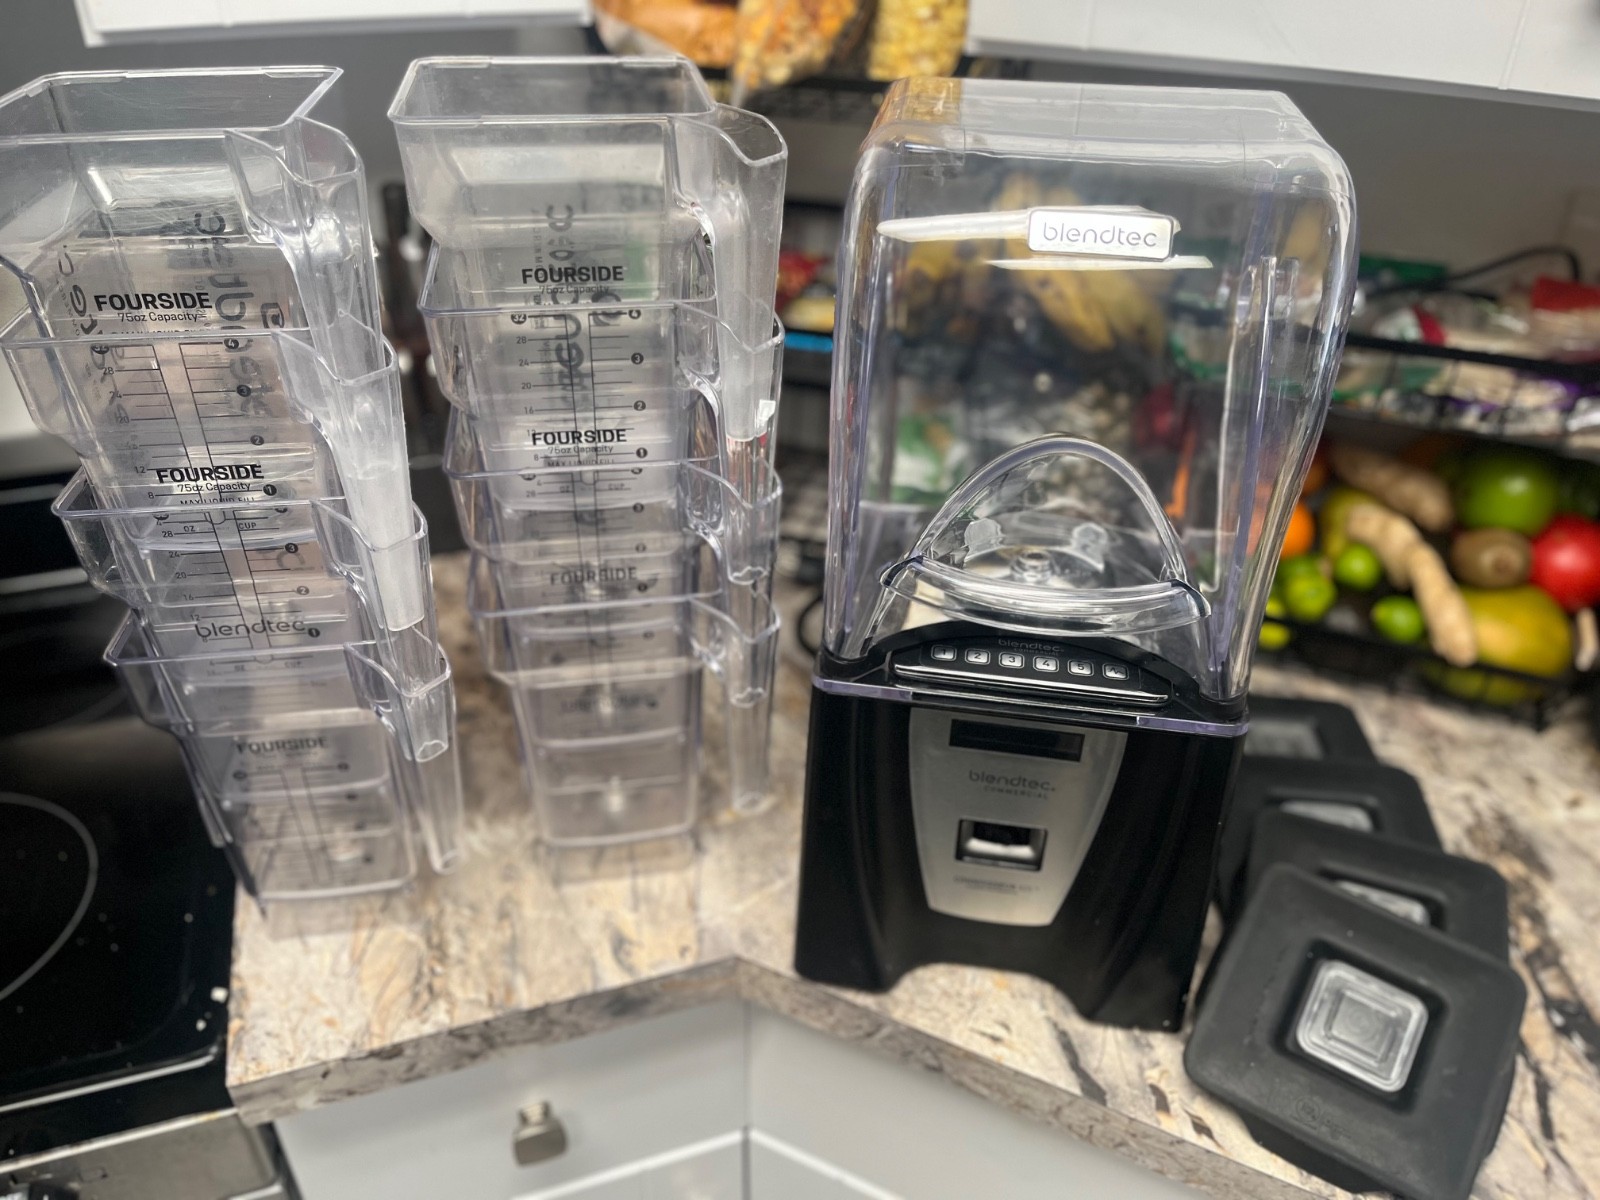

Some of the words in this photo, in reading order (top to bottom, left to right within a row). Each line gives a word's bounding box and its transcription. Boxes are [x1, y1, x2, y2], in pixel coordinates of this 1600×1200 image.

[1043, 221, 1158, 247] blendtec
[521, 265, 625, 285] FOURSIDE
[539, 285, 564, 295] 75oz
[566, 284, 610, 295] Capacity
[93, 292, 213, 312] FOURSIDE
[117, 312, 148, 323] 75oz
[149, 311, 198, 323] Capacity
[516, 336, 527, 344] 28
[519, 359, 529, 367] 24
[632, 353, 643, 364] 3
[102, 366, 115, 375] 28
[521, 382, 532, 390] 20
[634, 400, 645, 411] 2
[251, 435, 263, 445] 2
[531, 428, 627, 446] FOURSIDE
[573, 444, 614, 454] Capacity
[155, 464, 264, 484] FOURSIDE
[177, 484, 204, 493] 75oz
[206, 482, 251, 492] Capacity
[148, 491, 155, 499] 8
[183, 525, 196, 533] OZ
[238, 522, 257, 530] CUP
[169, 551, 181, 559] 24
[550, 567, 638, 586] FOURSIDE
[194, 619, 306, 639] blendtec
[973, 652, 982, 660] 2
[1042, 659, 1050, 667] 4
[1077, 663, 1085, 671] 5
